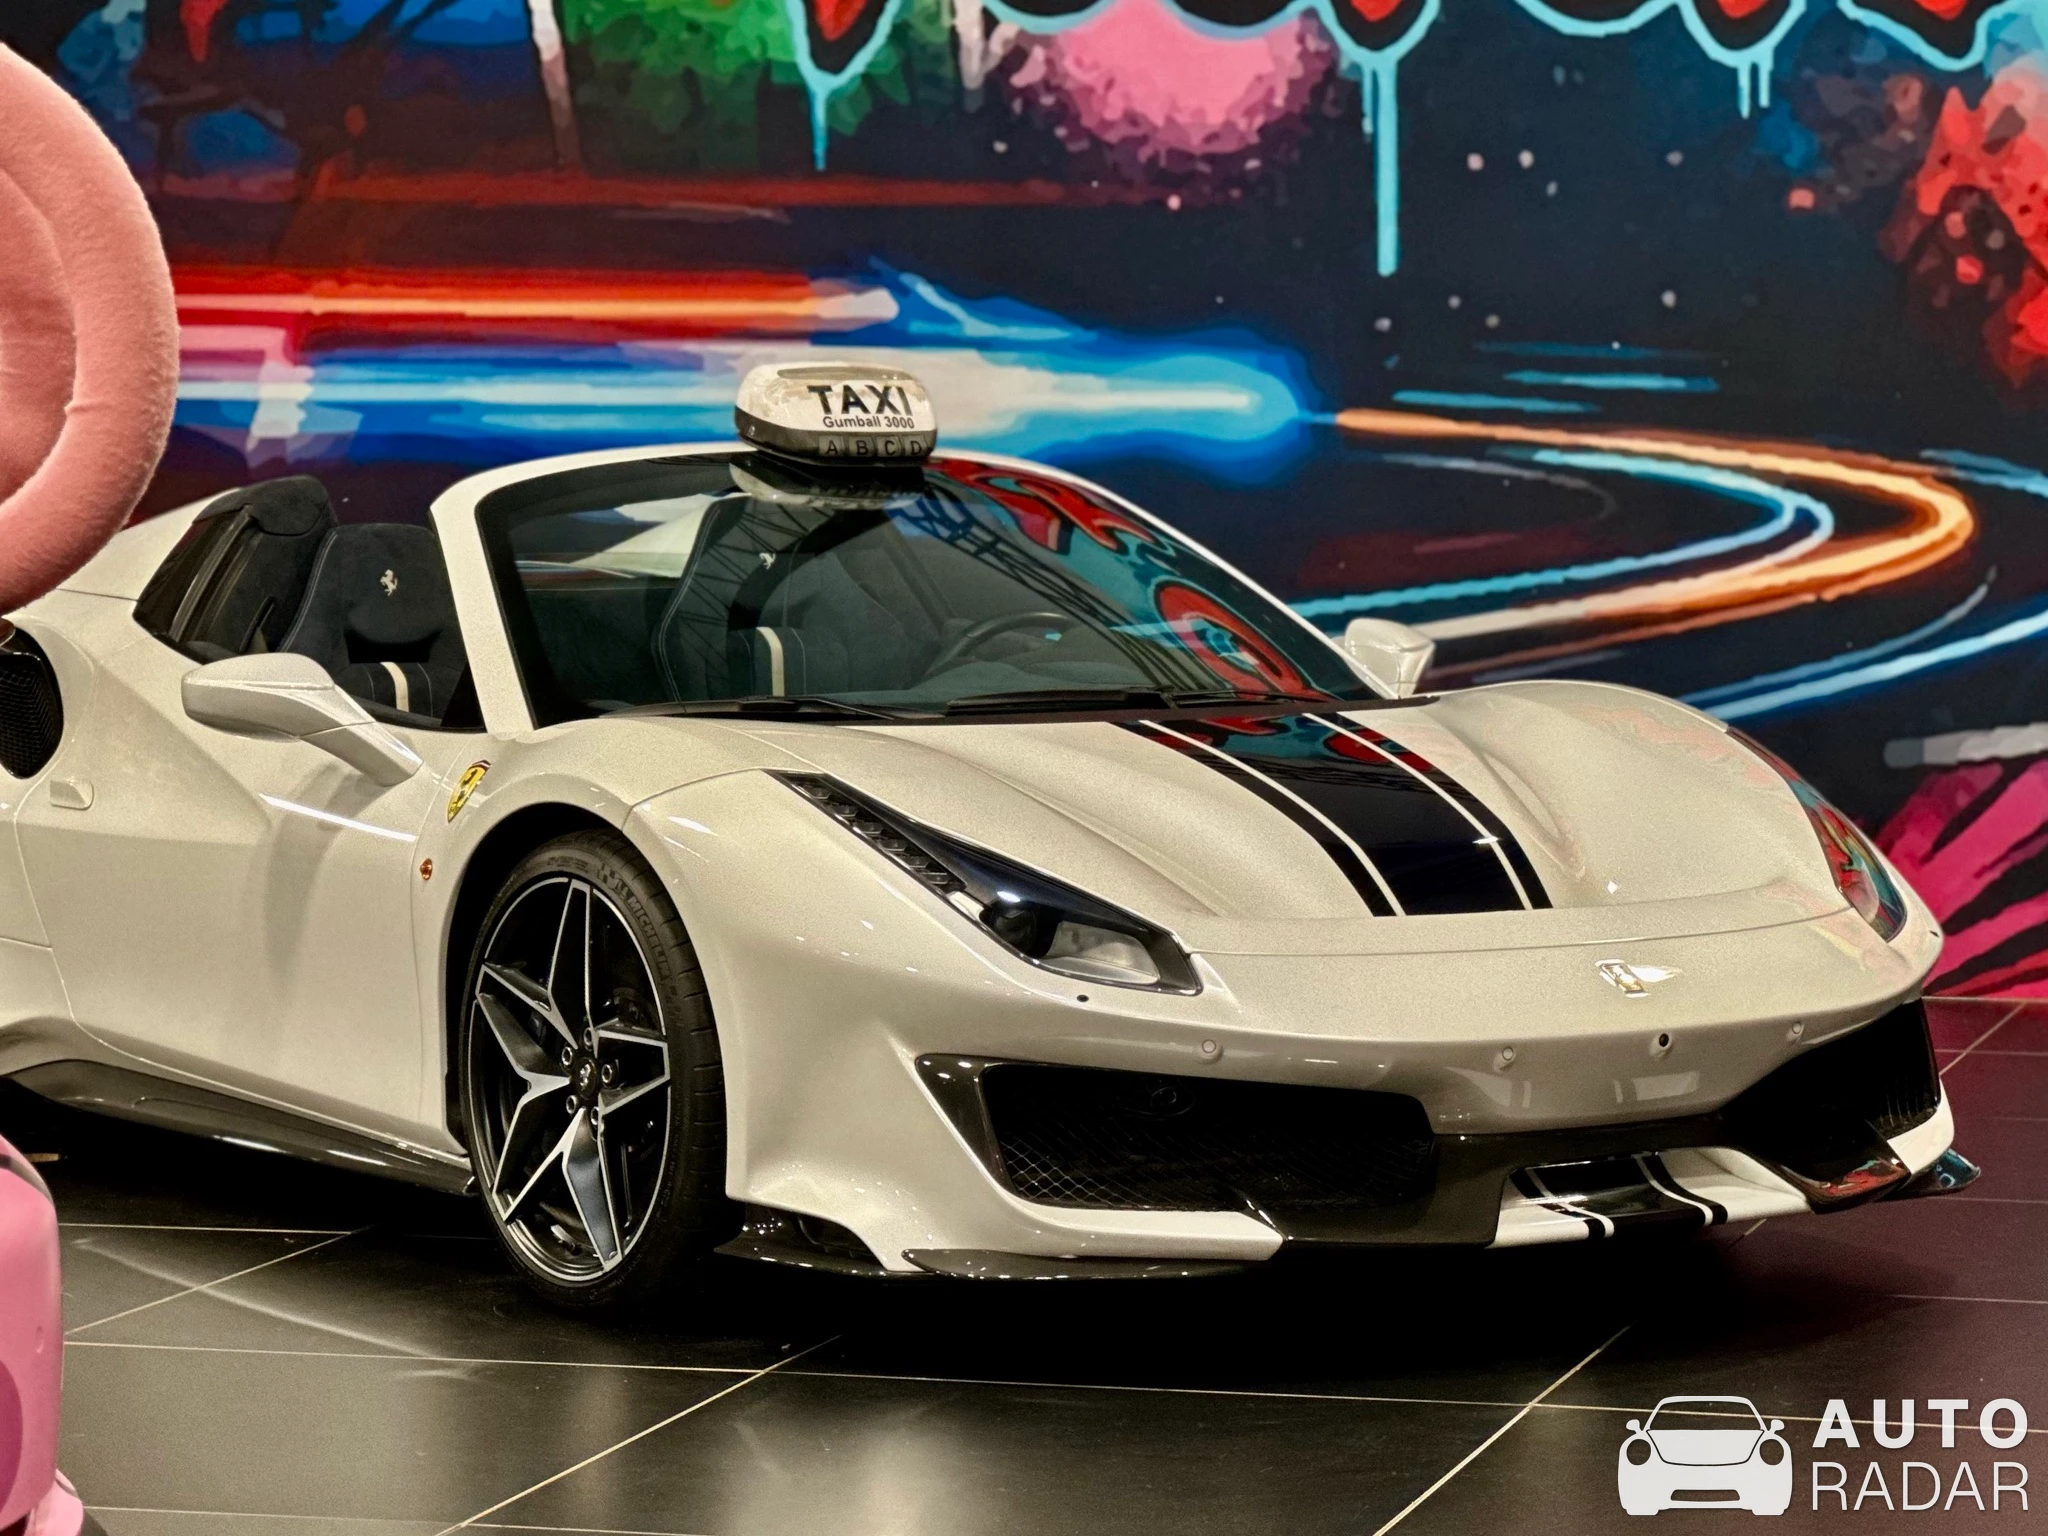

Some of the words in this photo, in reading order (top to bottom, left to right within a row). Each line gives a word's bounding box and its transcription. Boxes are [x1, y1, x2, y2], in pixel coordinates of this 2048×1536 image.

[808, 385, 912, 416] TAXI
[823, 415, 881, 429] Gumball
[884, 416, 915, 430] 3000
[825, 441, 839, 456] A
[855, 441, 869, 456] B
[884, 441, 897, 456] C
[910, 441, 923, 455] D
[627, 895, 673, 982] MICHELIN
